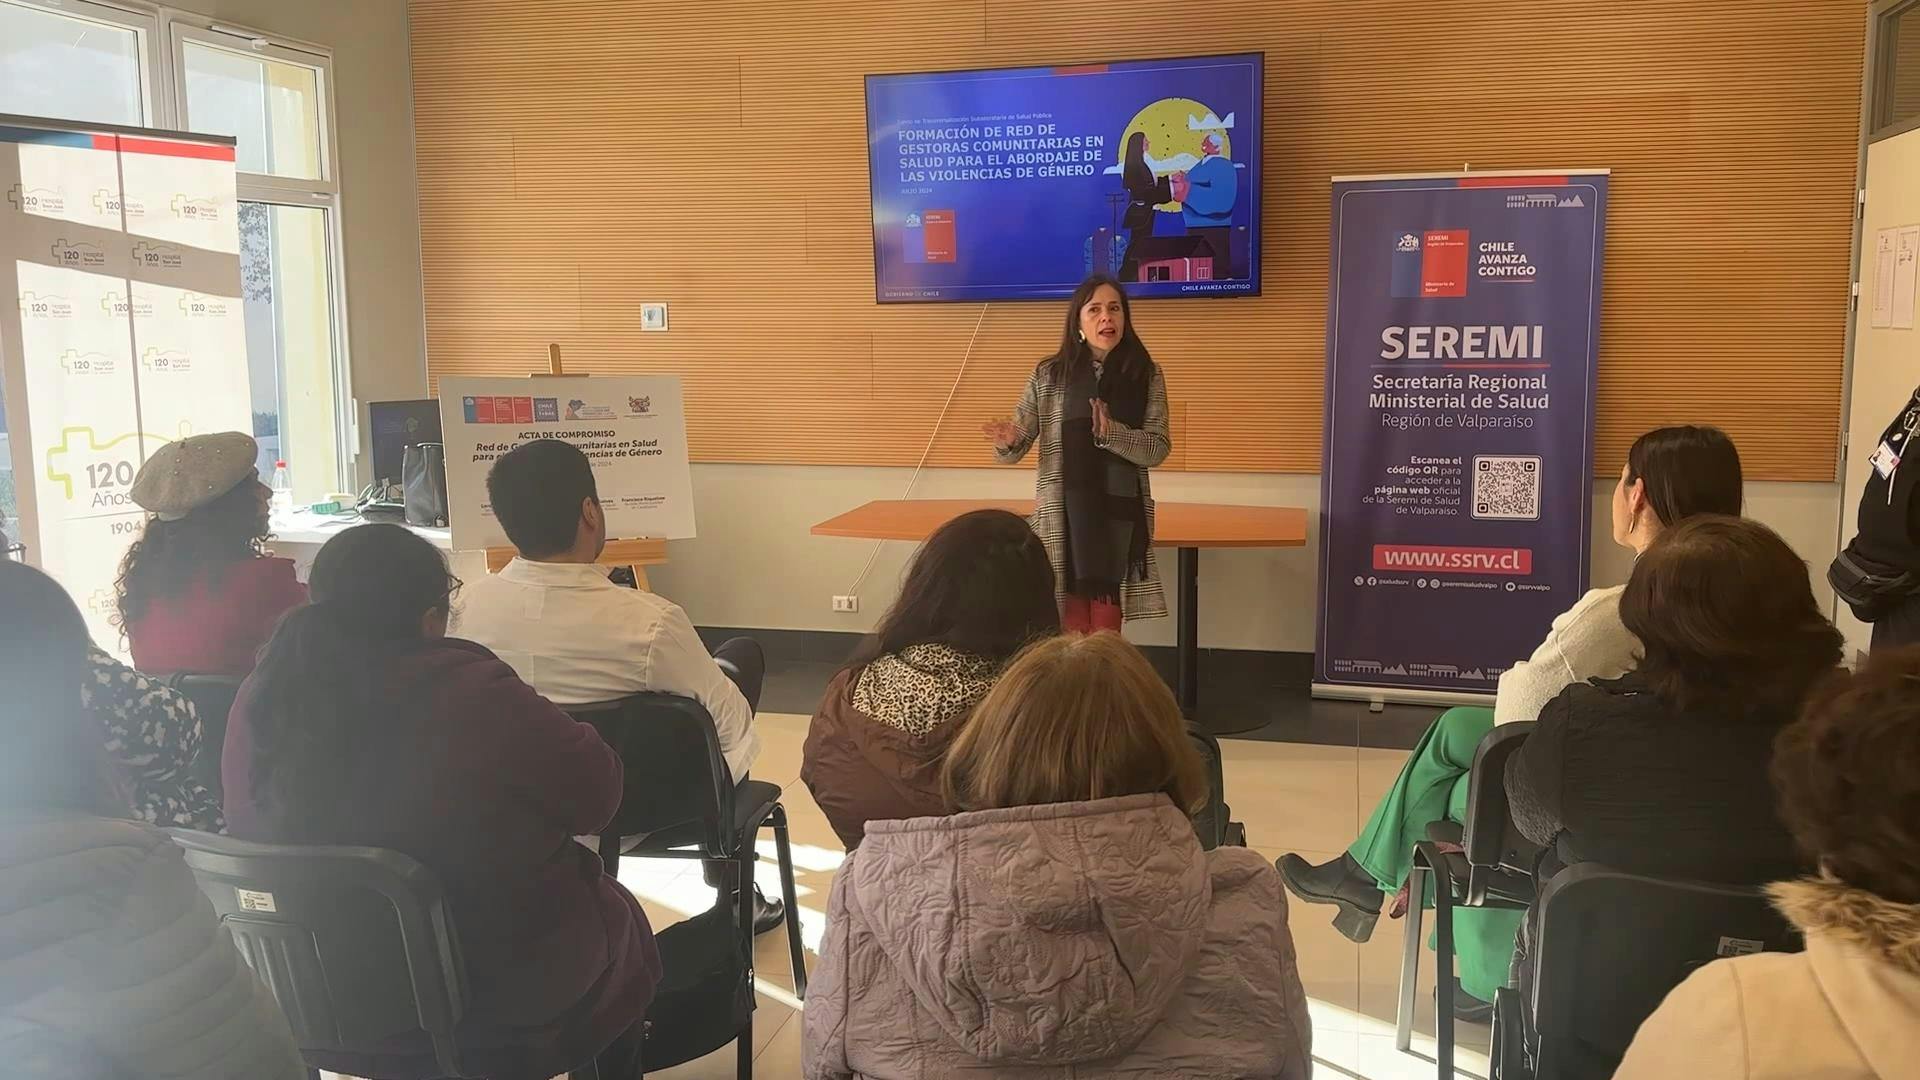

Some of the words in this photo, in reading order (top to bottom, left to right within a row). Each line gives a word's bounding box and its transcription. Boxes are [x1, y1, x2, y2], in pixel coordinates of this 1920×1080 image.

[898, 124, 980, 141] FORMACIÓN
[984, 127, 1002, 137] DE
[1006, 126, 1034, 136] RED
[1038, 124, 1056, 135] DE
[899, 142, 969, 155] GESTORAS
[973, 136, 1081, 152] COMUNITARIAS
[1085, 136, 1104, 147] EN
[900, 156, 943, 169] SALUD
[948, 154, 983, 166] PARA
[987, 154, 1003, 166] EL
[1007, 151, 1079, 165] ABORDAJE
[1084, 150, 1102, 161] DE
[900, 171, 925, 182] LAS
[929, 168, 1012, 181] VIOLENCIAS
[1016, 167, 1034, 178] DE
[1038, 163, 1094, 177] GÉNERO
[106, 202, 120, 210] 120
[183, 206, 197, 214] 120
[1479, 242, 1515, 252] CHILE
[64, 250, 80, 260] 120
[144, 254, 159, 262] 120
[1478, 254, 1528, 265] AVANZA
[1478, 266, 1536, 276] CONTIGO
[31, 304, 48, 312] 120
[114, 304, 129, 312] 120
[191, 304, 206, 312] 120
[1380, 326, 1543, 360] SEREMI
[74, 360, 90, 369] 120
[154, 358, 168, 367] 120
[1373, 374, 1463, 389] Secretaría
[1468, 374, 1547, 393] Regional
[1369, 394, 1466, 409] Ministerial
[1470, 394, 1492, 409] de
[1498, 394, 1549, 409] Salud
[1382, 412, 1431, 430] Región
[1434, 414, 1453, 428] de
[1457, 412, 1534, 430] Valparaíso
[518, 432, 540, 440] ACTA
[555, 430, 616, 439] COMPROMISO
[476, 443, 495, 452] Red
[496, 443, 508, 452] de
[632, 439, 658, 448] Salud
[472, 454, 494, 462] para
[628, 448, 662, 457] Género
[1410, 456, 1451, 465] Escanea
[1452, 456, 1462, 465] el
[86, 461, 134, 489] 120
[1386, 465, 1422, 476] código
[1423, 466, 1438, 475] QR
[1440, 468, 1462, 476] para
[1404, 476, 1442, 485] acceder
[1452, 477, 1461, 486] la
[1374, 485, 1408, 496] página
[1410, 486, 1430, 495] web
[1432, 486, 1460, 496] oficial
[92, 491, 132, 508] Años
[1362, 496, 1374, 504] de
[1376, 496, 1384, 504] la
[1386, 496, 1418, 504] Seremi
[1420, 496, 1432, 505] de
[1435, 497, 1460, 506] Salud
[1395, 506, 1408, 514] de
[110, 520, 142, 535] 1904
[1384, 550, 1520, 570] www.ssrv.cl
